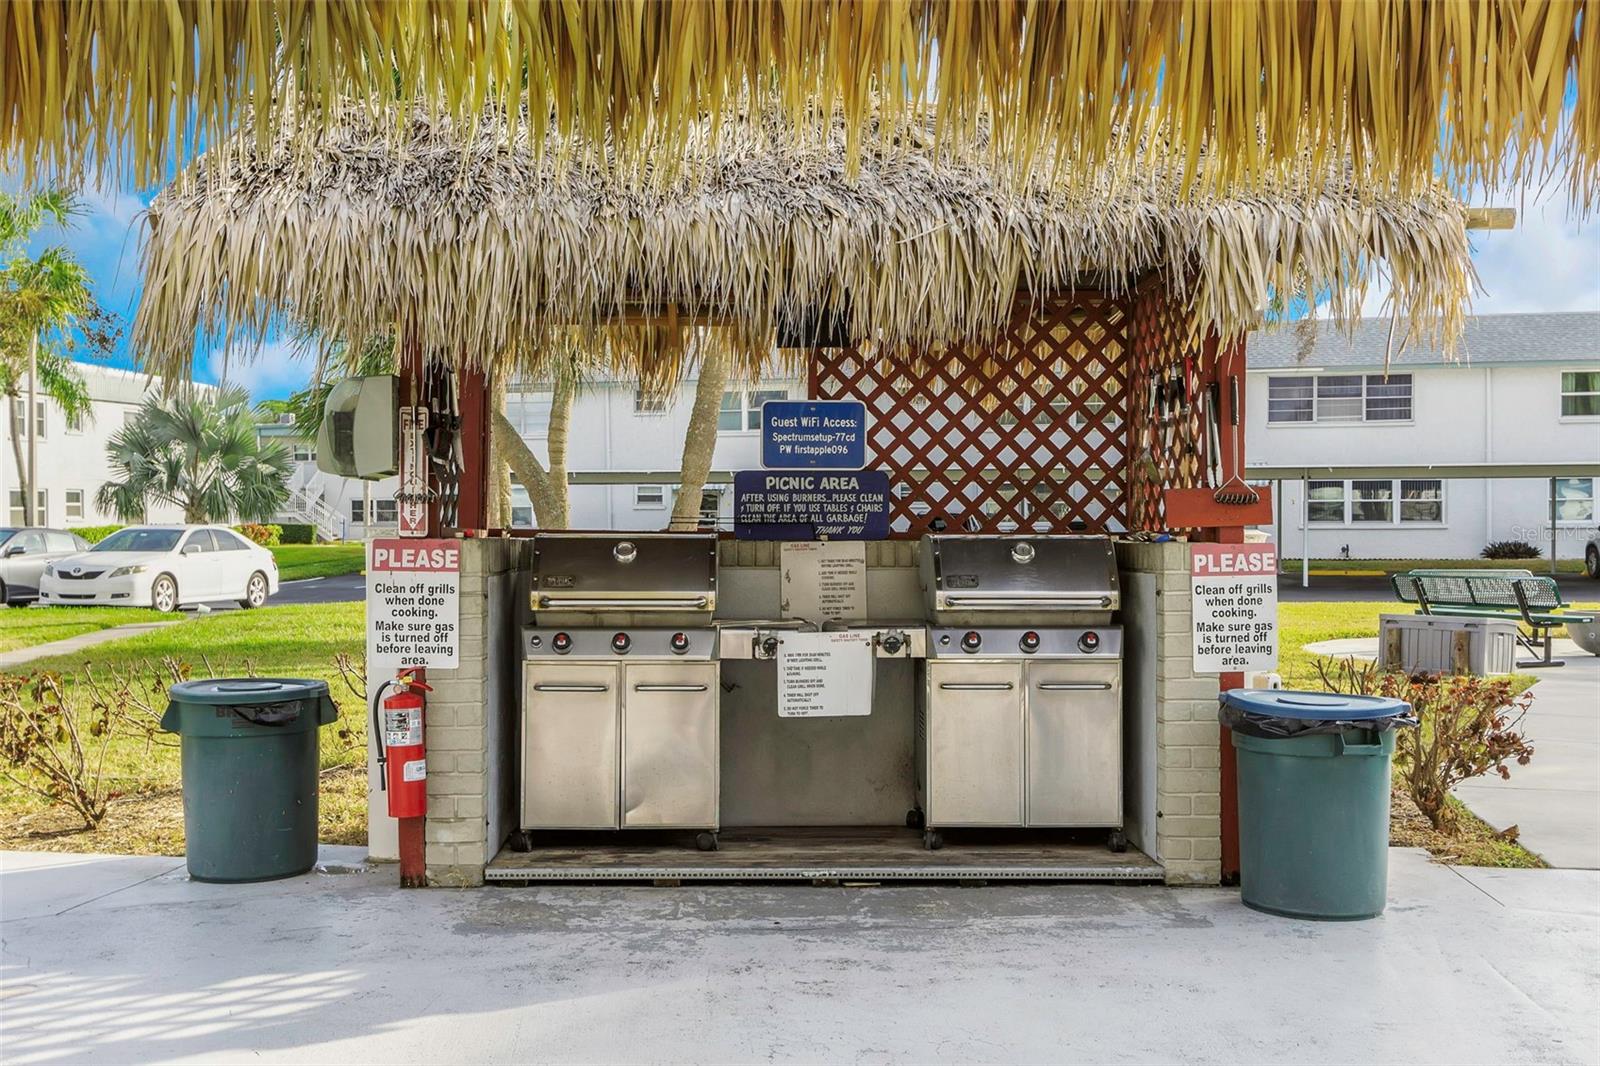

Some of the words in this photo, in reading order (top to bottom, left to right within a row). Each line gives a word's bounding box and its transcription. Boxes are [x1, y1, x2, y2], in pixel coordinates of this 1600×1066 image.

[772, 417, 798, 428] Guest
[801, 417, 820, 427] WiFi
[823, 417, 856, 428] Access:
[772, 433, 856, 443] Spectrumsetup-77cd
[780, 446, 792, 454] PW
[794, 445, 848, 455] firstapple096
[766, 476, 815, 490] PICNIC
[820, 477, 859, 490] AREA
[741, 494, 764, 502] AFTER
[768, 494, 789, 502] USING
[832, 494, 856, 502] PLEASE
[860, 494, 883, 502] CLEAN
[746, 504, 764, 512] TURN
[784, 504, 791, 512] IF
[794, 504, 806, 512] YOU
[809, 504, 820, 512] USE
[824, 504, 847, 512] TABLES
[857, 504, 883, 512] CHAIRS
[741, 514, 761, 522] CLEAN
[763, 514, 776, 522] THE
[778, 514, 797, 522] AREA
[799, 514, 808, 522] OF
[811, 514, 823, 522] ALL
[826, 513, 868, 523] GARBAGE!
[816, 526, 845, 534] THANK
[847, 526, 864, 534] YOU
[374, 548, 458, 569] PLEASE
[1194, 553, 1275, 573] PLEASE
[375, 583, 406, 594] Clean
[410, 584, 424, 593] off
[428, 584, 455, 596] grills
[1195, 585, 1225, 595] Clean
[1228, 584, 1243, 594] off
[1246, 584, 1273, 596] grills
[385, 596, 414, 605] when
[418, 596, 445, 605] done
[1205, 596, 1234, 606] when
[1237, 596, 1263, 606] done
[392, 607, 438, 620] cooking.
[1212, 608, 1257, 620] cooking.
[376, 621, 404, 631] Make
[408, 623, 432, 631] sure
[435, 623, 454, 634] gas
[1197, 622, 1224, 632] Make
[1228, 624, 1251, 632] sure
[1254, 623, 1272, 634] gas
[382, 634, 391, 642] is
[394, 633, 430, 642] turned
[434, 633, 449, 642] off
[1203, 635, 1211, 643] is
[1215, 633, 1250, 643] turned
[1253, 633, 1267, 642] off
[376, 644, 411, 654] before
[415, 644, 453, 656] leaving
[1198, 645, 1232, 655] before
[1235, 644, 1272, 655] leaving
[401, 656, 429, 665] area.
[1222, 657, 1249, 666] area.
